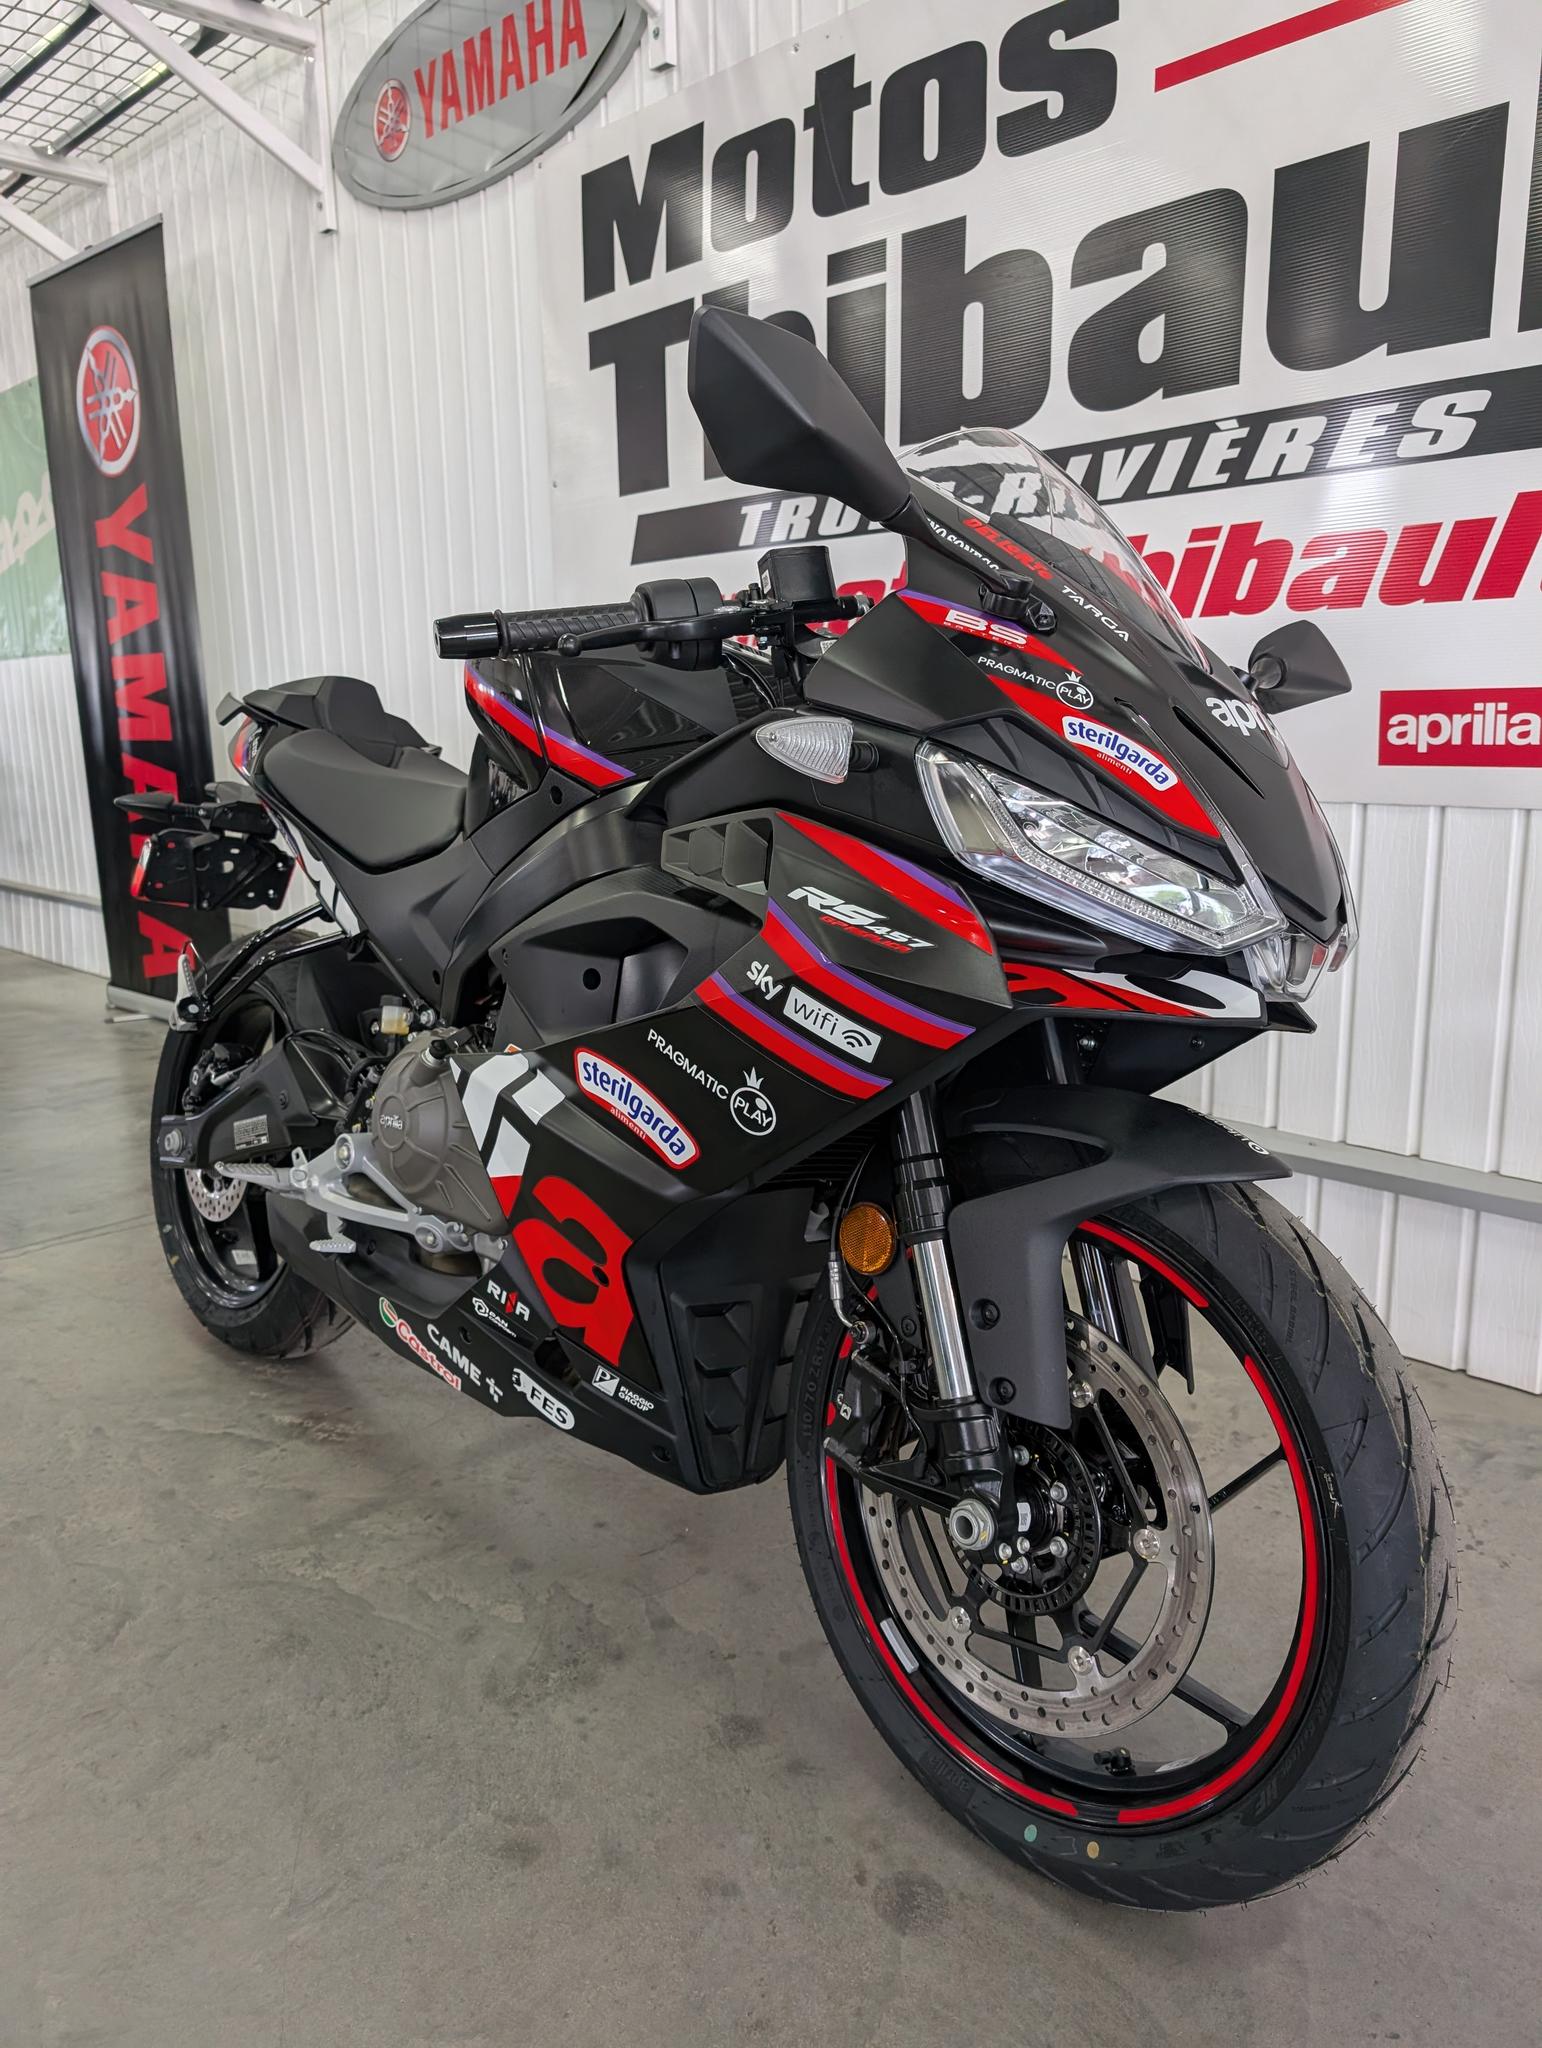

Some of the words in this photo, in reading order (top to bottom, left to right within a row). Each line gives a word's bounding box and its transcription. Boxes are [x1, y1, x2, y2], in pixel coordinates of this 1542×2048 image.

[414, 0, 588, 139] YAMAHA
[581, 0, 1119, 302] Motos
[589, 60, 1542, 497] Tibau
[945, 609, 1028, 645] BS
[1061, 585, 1129, 642] TARGA
[977, 656, 1056, 690] PRAGMATIC
[1060, 686, 1091, 706] PLAY
[95, 483, 197, 980] YAMAA
[1068, 720, 1169, 786] sterilgarda
[1387, 702, 1542, 753] aprilia
[1096, 751, 1133, 775] alimenti
[787, 886, 889, 926] RS
[864, 925, 936, 948] 457
[746, 960, 784, 1000] sky
[792, 997, 840, 1036] wifi
[647, 1028, 729, 1100] PRAGMATIC
[582, 1061, 686, 1156] sterilgarda
[610, 1106, 647, 1139] alimenti
[735, 1097, 773, 1127] PLAY
[396, 1318, 461, 1392] Castrol
[427, 1323, 482, 1387] CAME
[530, 1386, 569, 1425] FES
[617, 1391, 650, 1412] GROUP
[619, 1385, 655, 1410] PIAGGIO
